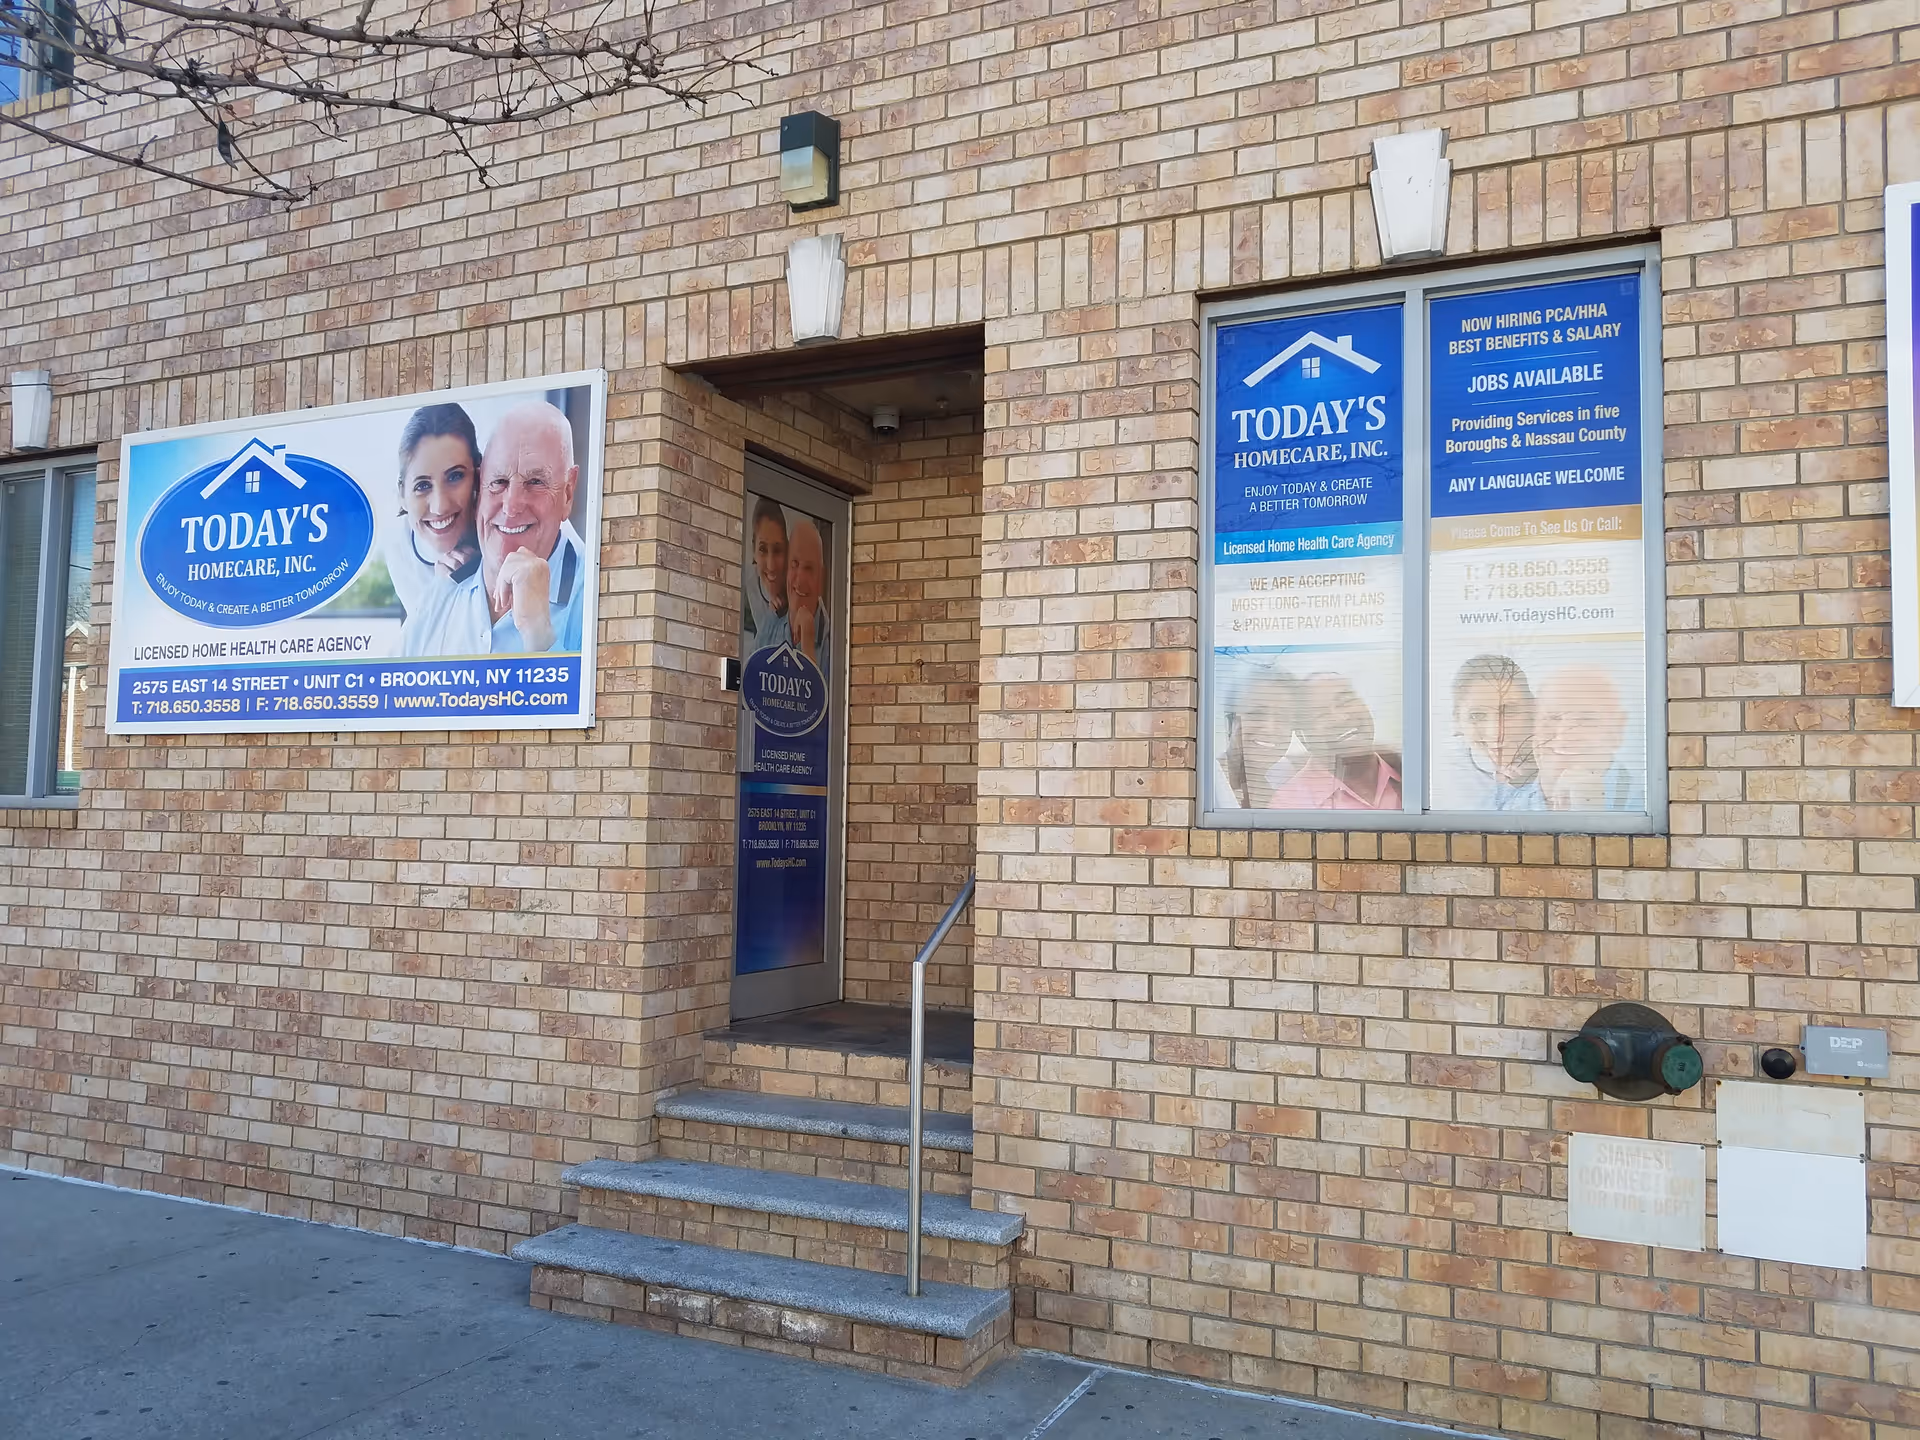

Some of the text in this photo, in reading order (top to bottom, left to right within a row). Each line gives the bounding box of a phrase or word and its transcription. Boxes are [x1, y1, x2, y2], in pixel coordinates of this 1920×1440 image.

[1461, 302, 1608, 333] NOW HIRING PCA/HHA
[1449, 322, 1622, 355] BEST BENEFITS & SALARY
[1467, 363, 1604, 394] JOBS AVAILABLE
[1232, 395, 1386, 443] TODAY'S
[1452, 404, 1620, 432] Providing Services in five
[1446, 426, 1627, 454] Boroughs & Nassau County
[1234, 440, 1388, 469] HOMECARE, INC.
[1245, 477, 1373, 498] ENJOY TODAY & CREATE
[1448, 466, 1625, 493] ANY LANGUAGE WELCOME
[1250, 494, 1368, 513] A BETTER TOMORROW
[181, 504, 329, 554] TODAY'S
[1490, 524, 1521, 538] Come
[1524, 522, 1537, 535] To
[1540, 520, 1561, 535] See
[1564, 519, 1578, 533] Us
[1581, 518, 1594, 532] Or
[1596, 516, 1623, 532] Call:
[1224, 533, 1395, 555] Licensed Home Health Care Agency
[188, 555, 316, 581] HOMECARE, INC.
[1464, 558, 1609, 580] T: 718.650.3558
[156, 558, 350, 615] ENJOY TODAY & CREATE A BETTER TOMORROW
[1250, 572, 1365, 591] WE ARE ACCEPTING
[1464, 578, 1610, 600] F: 718.650.3559
[1232, 592, 1385, 612] MOST LONG-TERM PLANS
[1232, 613, 1384, 631] & PRIVATE PAY PATIENTS
[1460, 606, 1615, 624] www.TodaysHC.com
[134, 635, 372, 661] LICENSED HOME HEALTH CARE AGENCY
[132, 667, 569, 695] 2575 EAST 14 STREET UNIT C1 BROOKLYN, NY 11235
[759, 672, 812, 699] TODAY'S
[132, 690, 568, 715] T: 718.650.3558 F: 718.650.3559 www.TodaysHC.com
[762, 697, 809, 713] HOMECARE, INC.
[762, 749, 806, 761] LICENSED HOME
[754, 762, 813, 775] HEALTH CARE AGENCY
[748, 808, 759, 817] 2575
[760, 808, 773, 818] EAST
[774, 809, 780, 818] 14
[800, 810, 810, 819] UNIT
[786, 822, 792, 831] NY
[756, 857, 807, 869] www.TodaysHC.com
[1830, 1036, 1863, 1049] DEP
